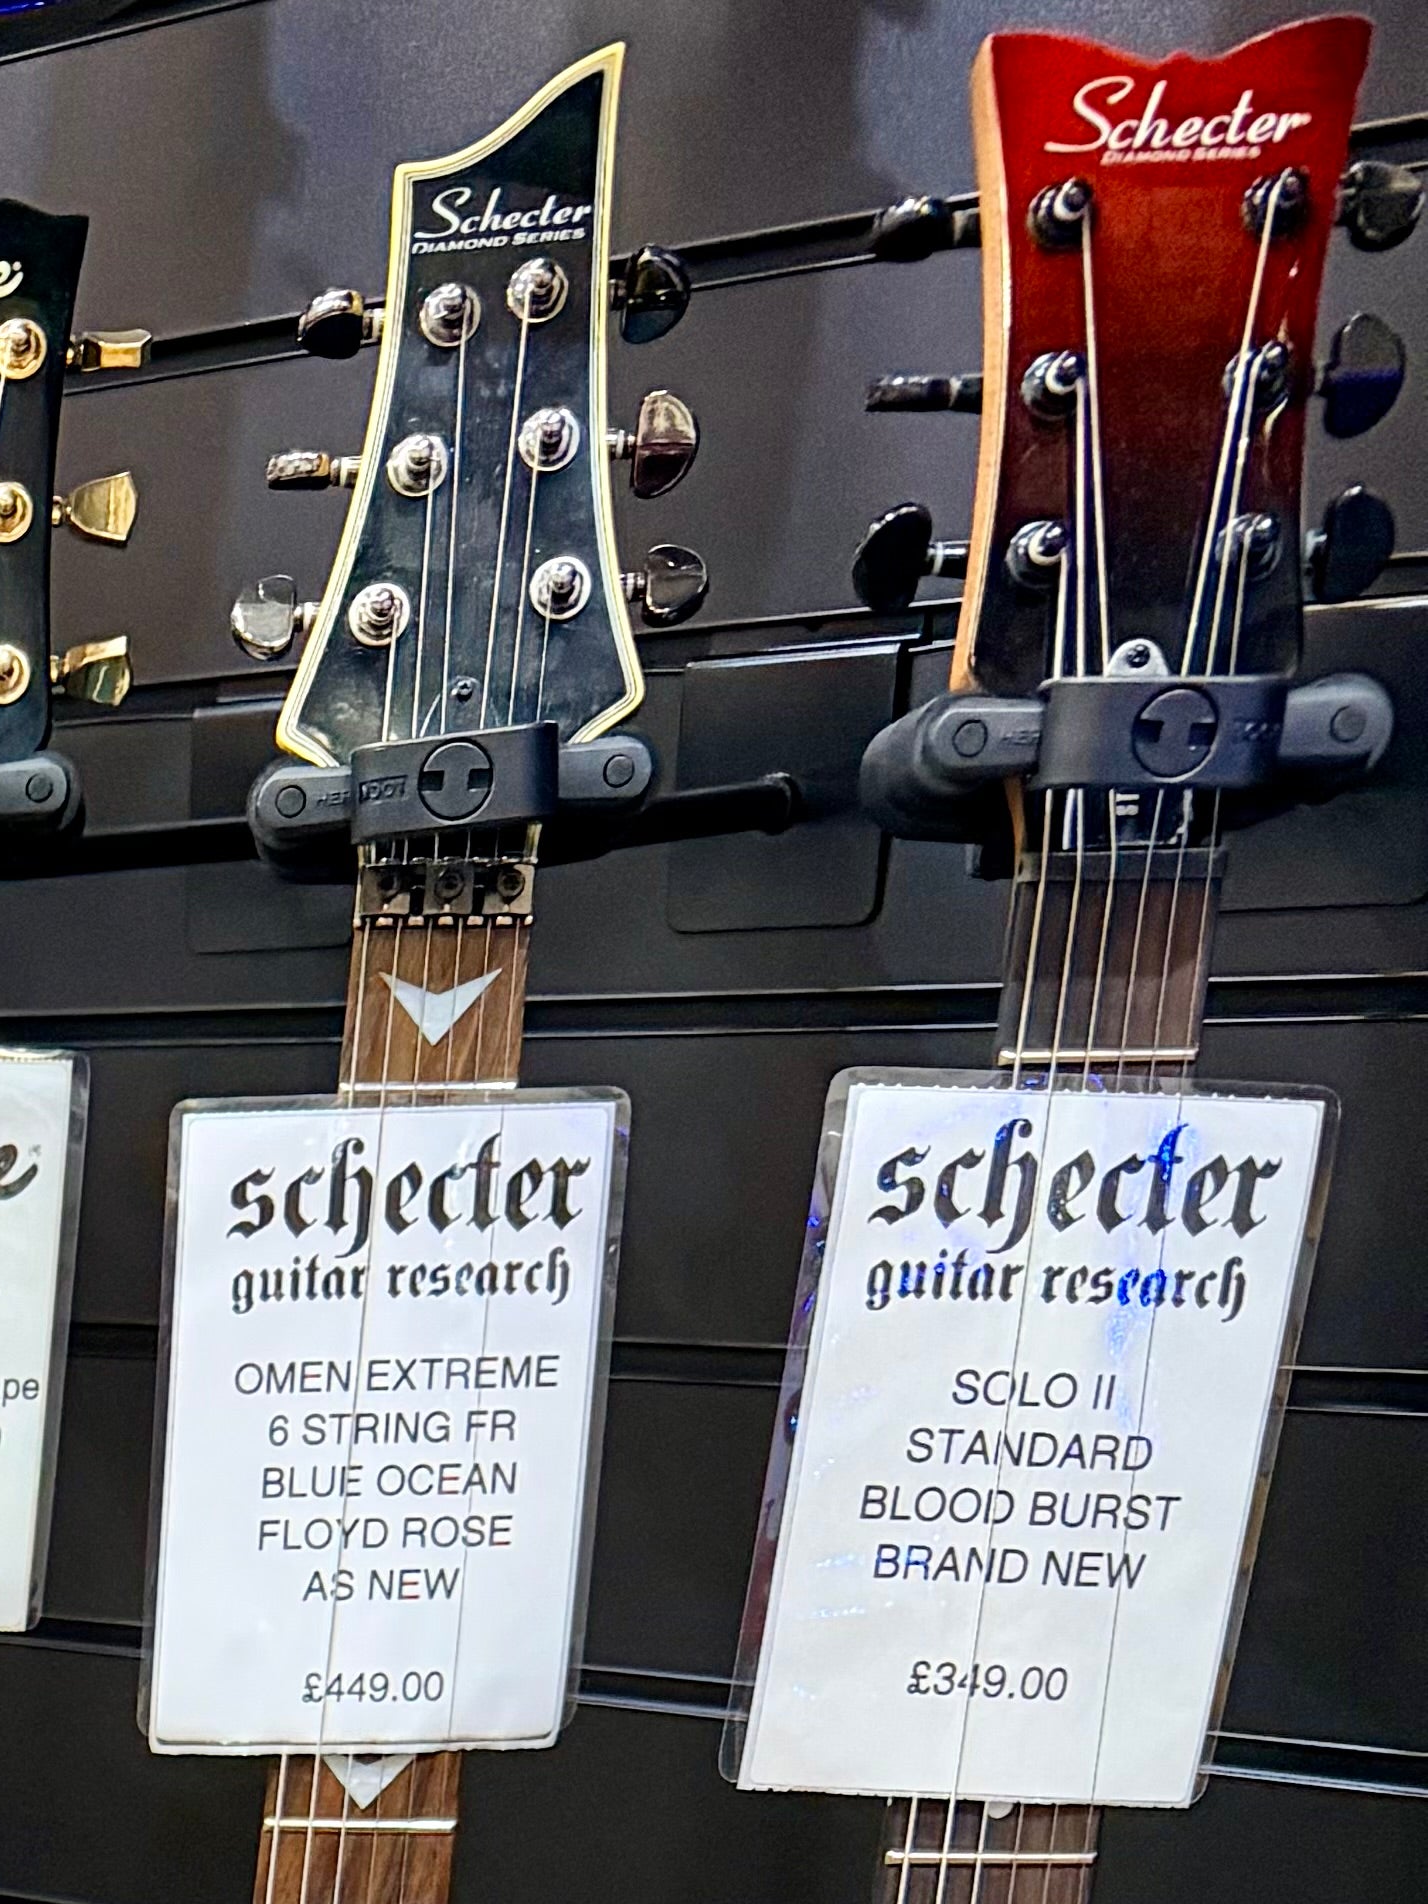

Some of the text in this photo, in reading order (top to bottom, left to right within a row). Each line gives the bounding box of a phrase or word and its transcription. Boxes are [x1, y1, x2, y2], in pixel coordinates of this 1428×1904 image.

[1044, 76, 1312, 153] Schecter
[1100, 150, 1191, 166] DIAMOND
[414, 186, 592, 238] Schecter
[412, 228, 585, 254] DIAMOND SERIES
[227, 1131, 591, 1258] schecter
[866, 1118, 1283, 1254] schecter
[232, 1246, 570, 1314] guitar research
[865, 1249, 1246, 1322] guitar research
[235, 1355, 560, 1395] OMEN EXTREME
[952, 1369, 1115, 1409] SOLO II
[269, 1410, 516, 1446] 6 STRING FR
[906, 1428, 1153, 1471] STANDARD
[262, 1464, 517, 1499] BLUE OCEAN
[860, 1486, 1181, 1531] BLOOD BURST
[258, 1516, 512, 1551] FLOYD ROSE
[303, 1567, 460, 1602] AS NEW
[873, 1544, 1145, 1589] BRAND NEW
[303, 1671, 444, 1703] £449.00
[907, 1660, 1067, 1700] £349.00
